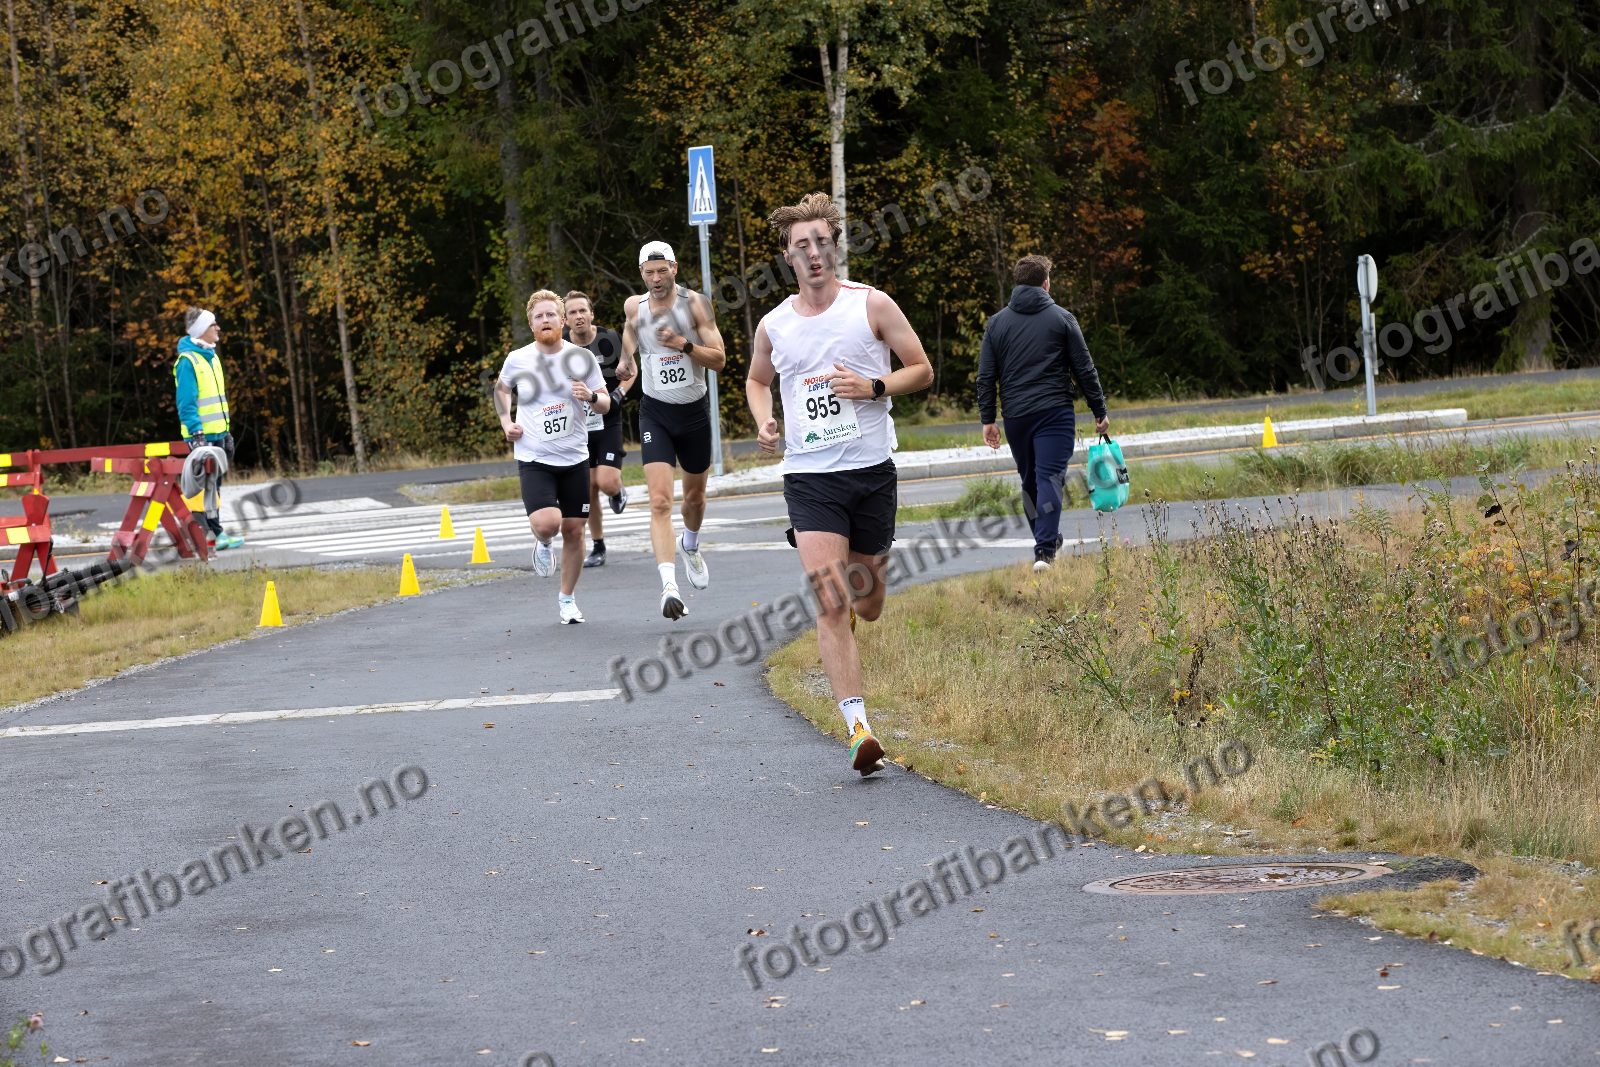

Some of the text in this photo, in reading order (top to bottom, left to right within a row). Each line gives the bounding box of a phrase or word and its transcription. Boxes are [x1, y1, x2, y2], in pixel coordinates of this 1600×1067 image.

[660, 367, 687, 384] 382
[806, 394, 841, 420] 955
[544, 416, 567, 434] 857
